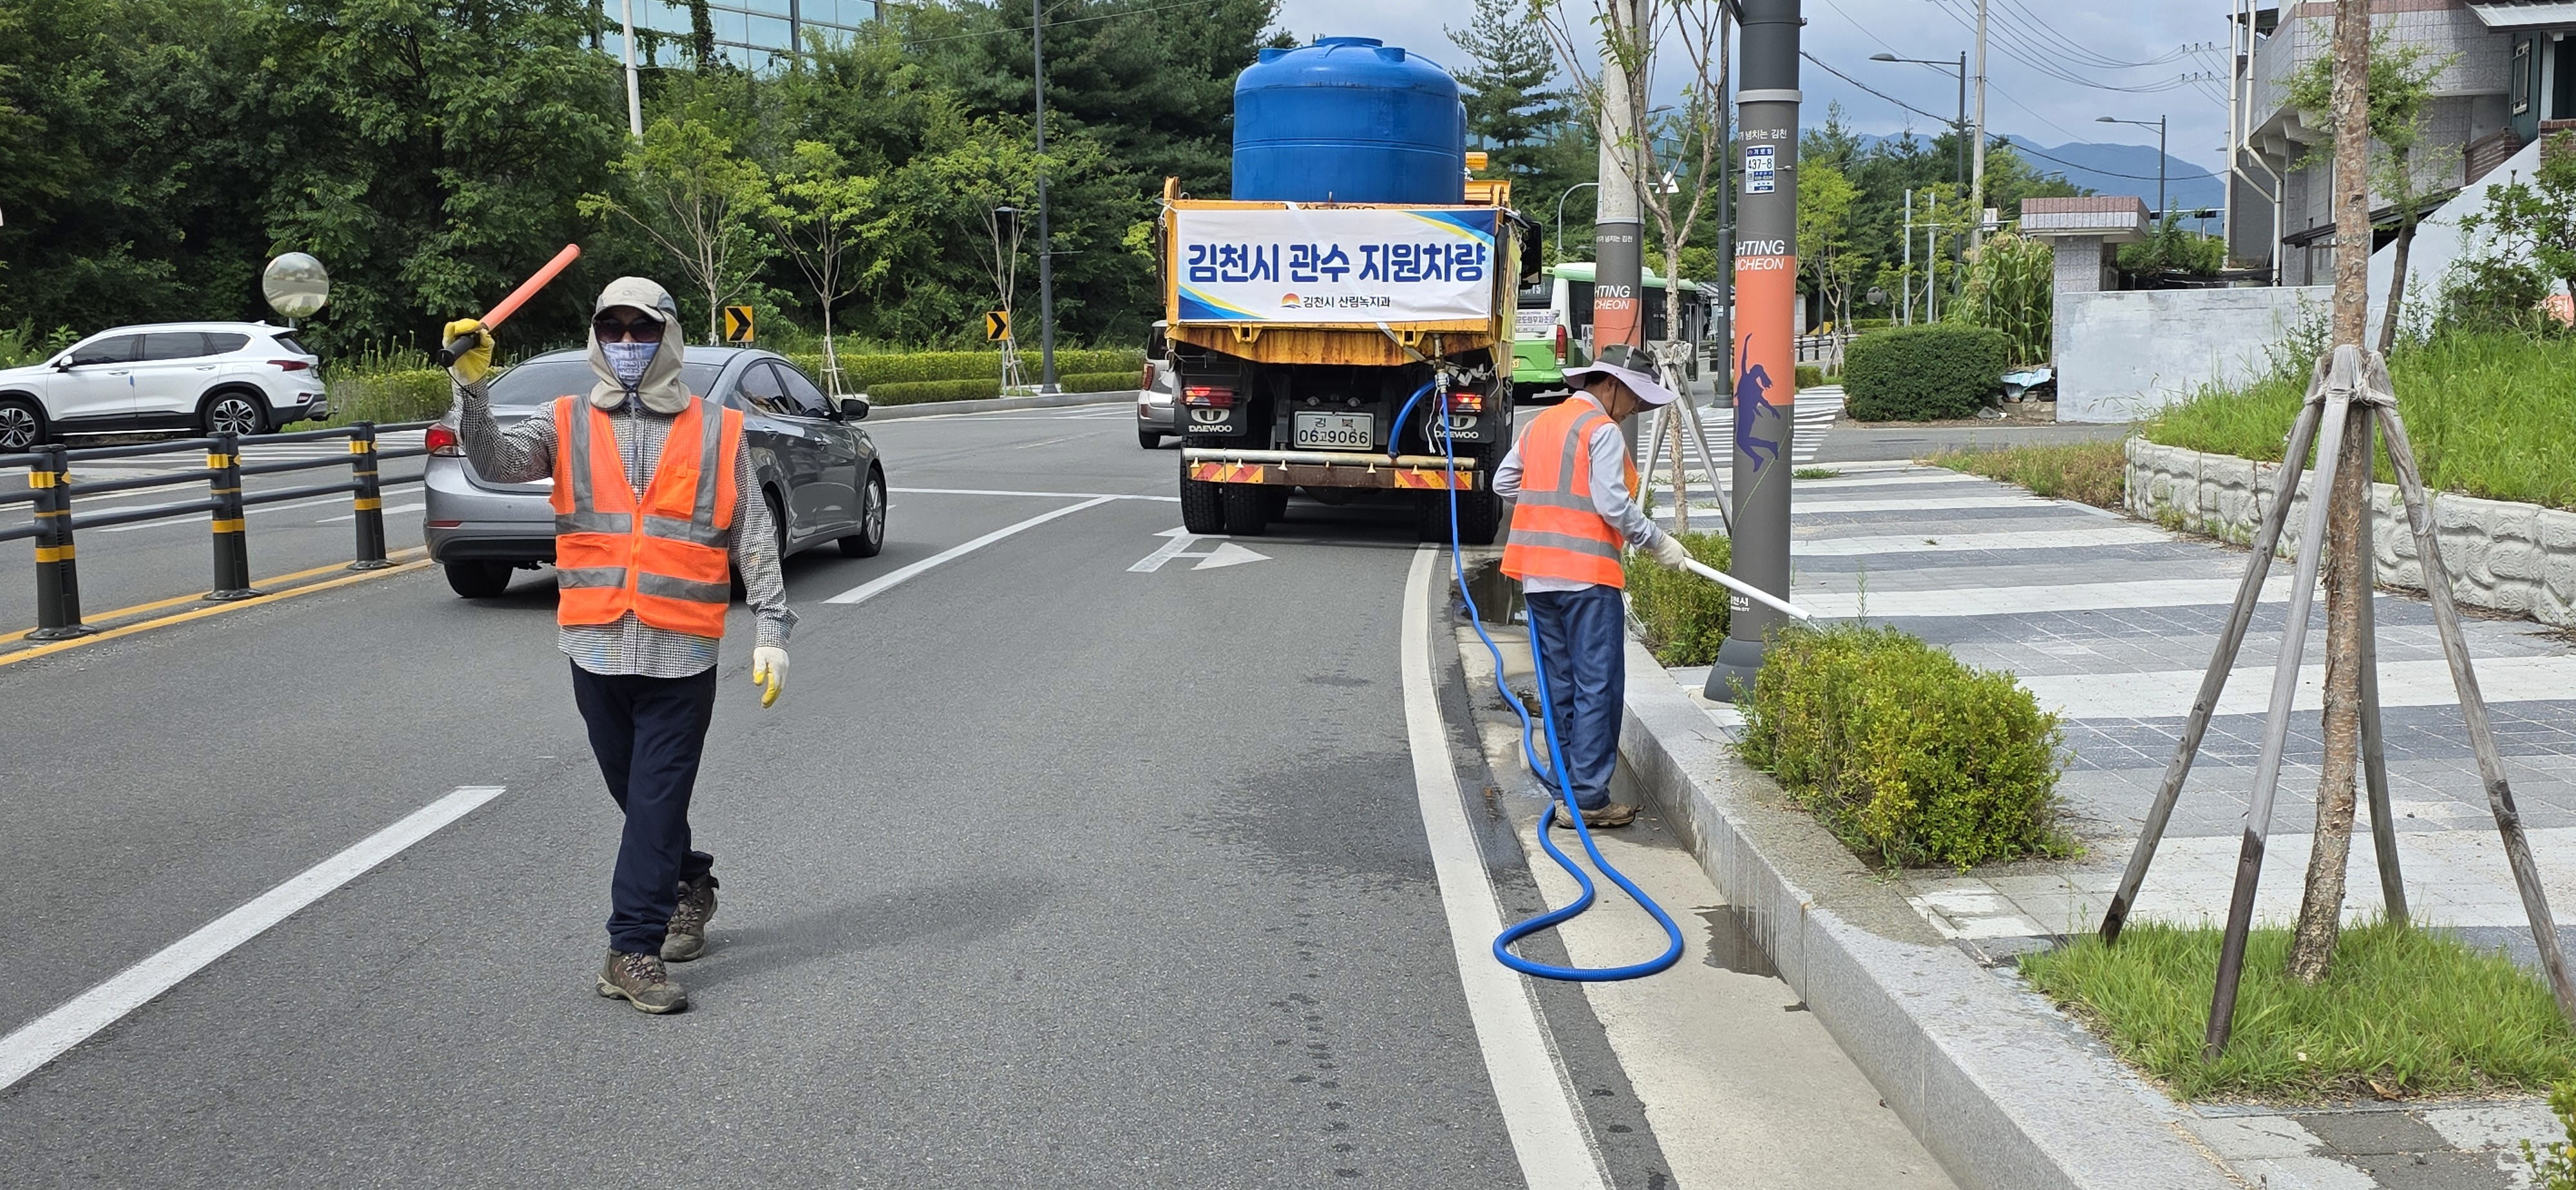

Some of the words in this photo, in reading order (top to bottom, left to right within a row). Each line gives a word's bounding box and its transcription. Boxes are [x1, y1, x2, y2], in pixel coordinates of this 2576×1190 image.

[1745, 129, 1768, 140] 넘치는
[1771, 128, 1787, 139] 김천
[1748, 158, 1772, 169] 437-8
[1736, 240, 1785, 256] HTING
[1188, 243, 1280, 282] 김천시
[1289, 243, 1350, 282] 관수
[1359, 243, 1486, 282] 지원차량
[1303, 296, 1334, 308] 김천시
[1338, 296, 1391, 308] 산림녹지과
[1300, 430, 1368, 444] 06고9066
